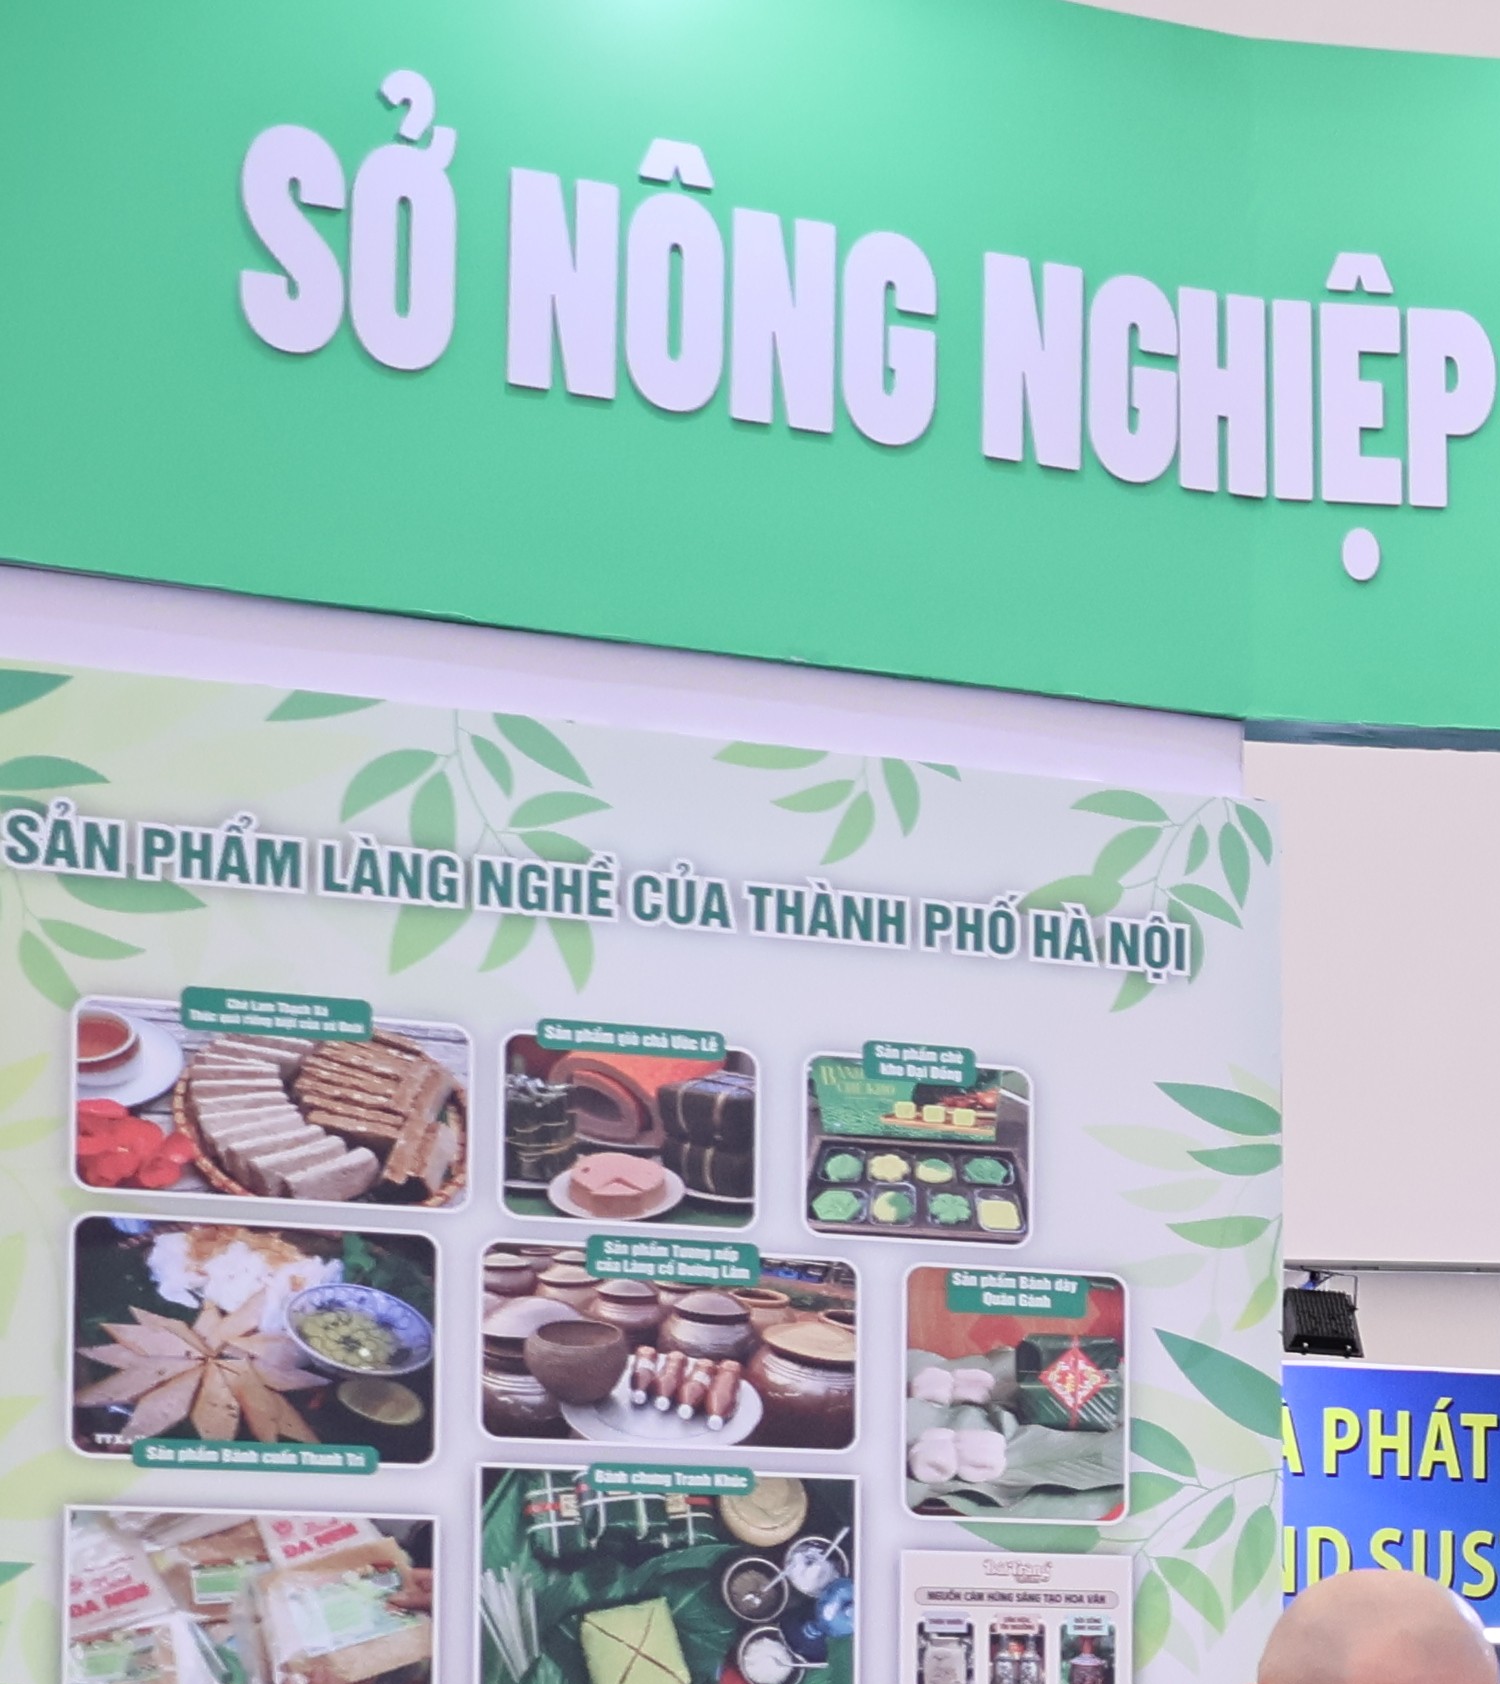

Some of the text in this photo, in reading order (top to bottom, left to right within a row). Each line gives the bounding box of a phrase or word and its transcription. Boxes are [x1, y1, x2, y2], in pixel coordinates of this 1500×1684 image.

[239, 68, 457, 371] SỞ
[506, 138, 938, 448] NÔNG
[981, 251, 1498, 582] NGHIỆP
[3, 796, 1191, 984] SẢN PHẨM LÀNG NGHỀ CỦA THÀNH PHỐ HÀ NỘI
[1322, 1397, 1499, 1484] PHÁT
